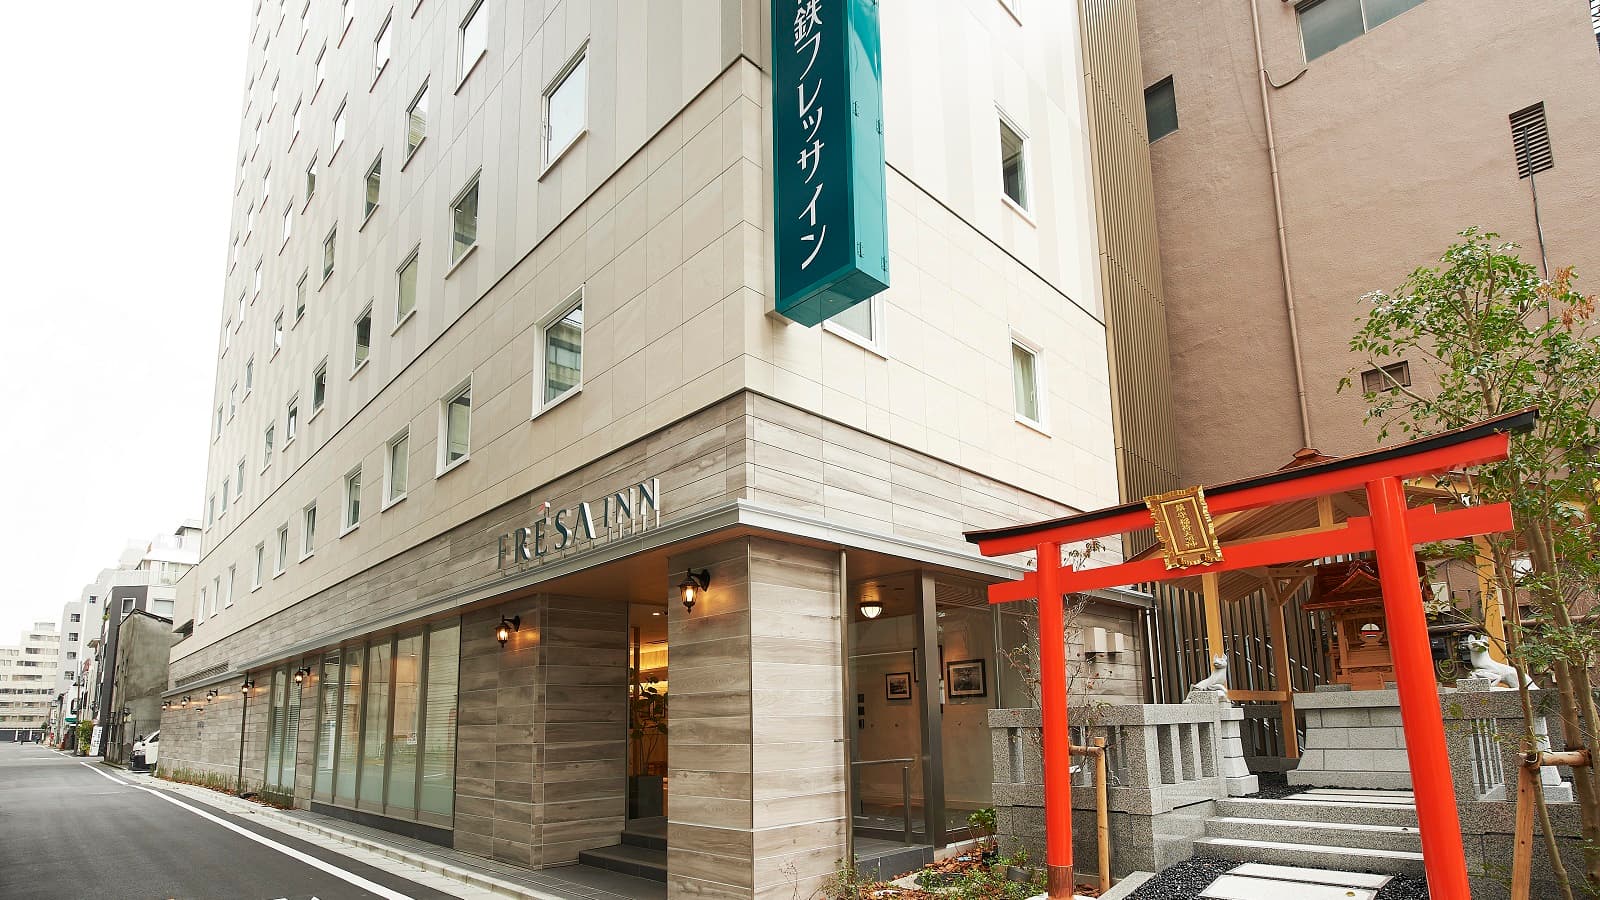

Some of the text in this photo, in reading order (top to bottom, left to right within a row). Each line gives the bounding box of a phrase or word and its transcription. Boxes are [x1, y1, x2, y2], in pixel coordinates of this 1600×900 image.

[794, 0, 827, 270] 鉄フレッサイン
[498, 478, 660, 570] FRÉSA INN
